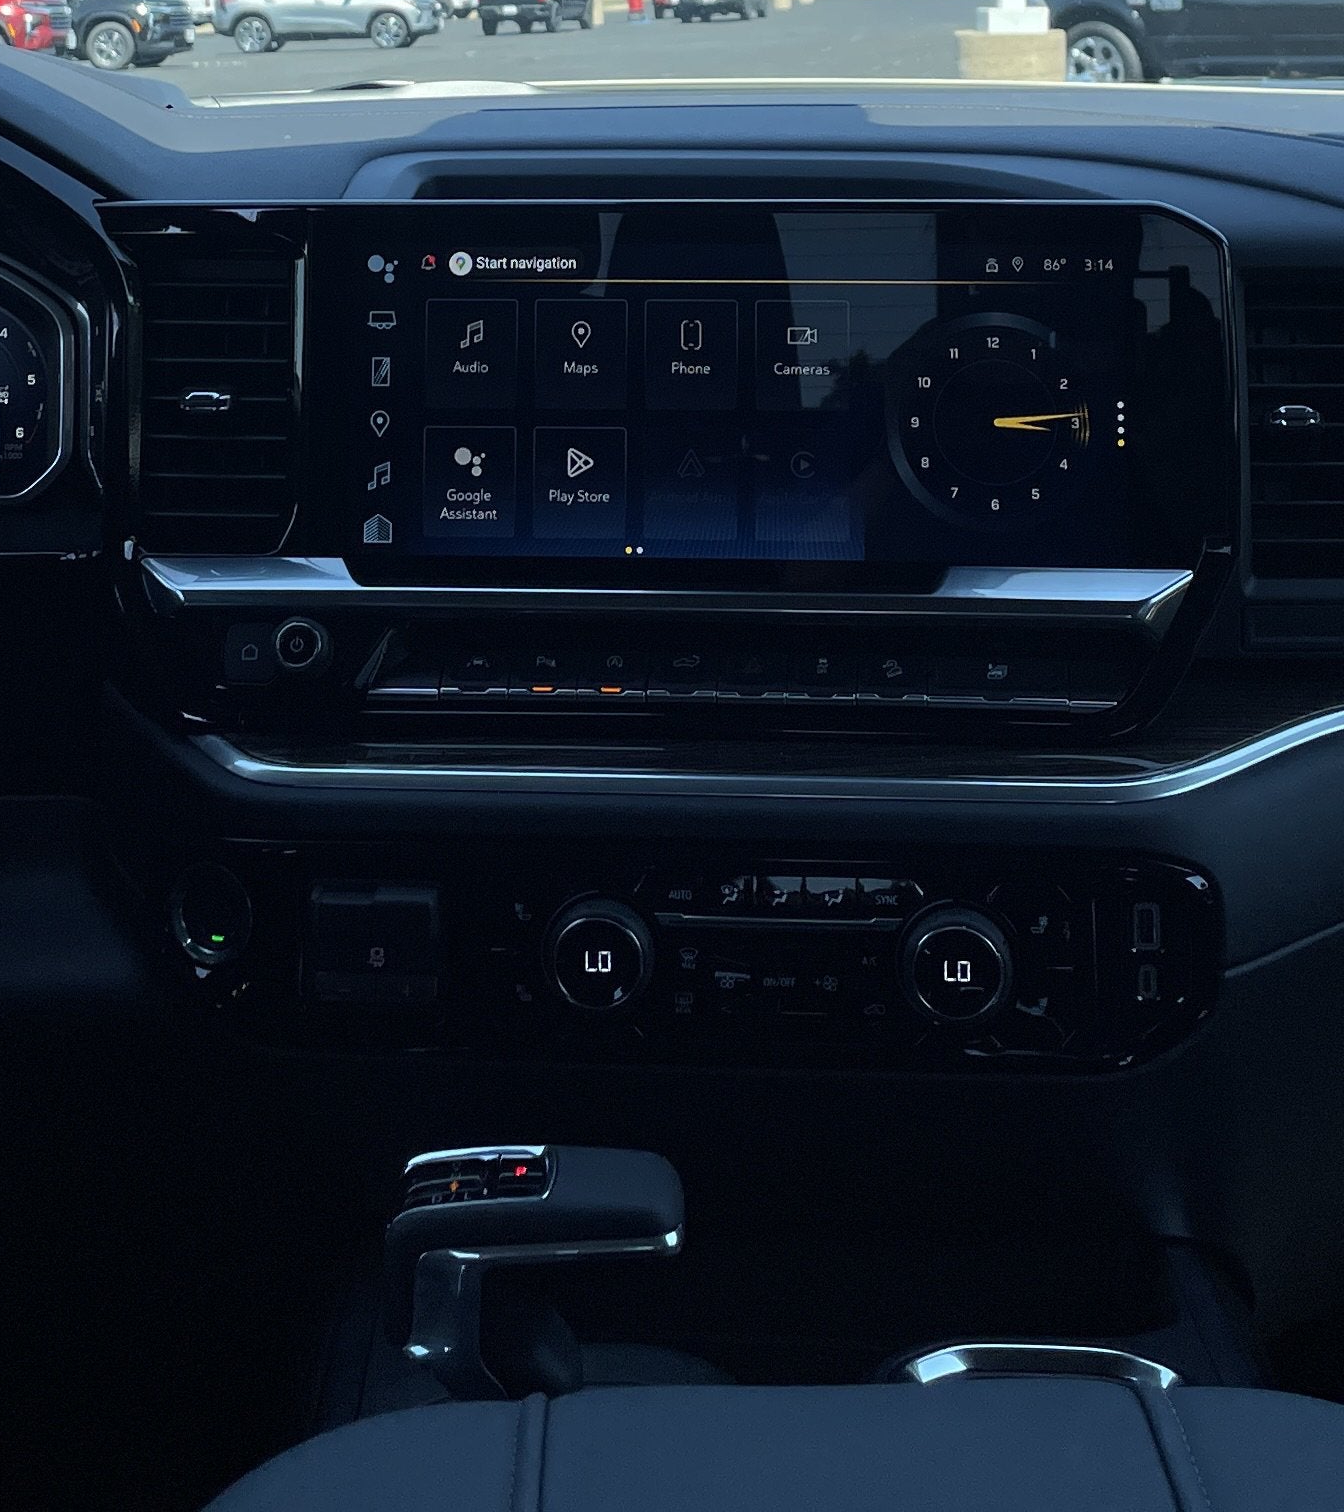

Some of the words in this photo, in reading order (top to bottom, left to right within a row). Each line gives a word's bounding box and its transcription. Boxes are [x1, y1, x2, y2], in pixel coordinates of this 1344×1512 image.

[476, 255, 507, 270] Start
[510, 255, 578, 273] navigation
[1084, 258, 1114, 271] 3:14
[0, 327, 8, 339] 4
[986, 337, 1000, 349] 12
[949, 348, 960, 360] 11
[1030, 348, 1037, 360] 1
[452, 360, 489, 374] Audio
[563, 362, 599, 377] Maps
[670, 361, 711, 375] Phone
[773, 363, 831, 376] Cameras
[27, 374, 36, 385] 5
[917, 377, 931, 389] 10
[1059, 379, 1069, 390] 2
[910, 417, 919, 429] 9
[1071, 418, 1080, 429] 3
[15, 427, 25, 438] 6
[920, 457, 930, 468] 8
[1059, 458, 1068, 470] 4
[446, 489, 492, 505] Google
[548, 490, 575, 506] Play
[577, 490, 611, 503] Store
[950, 488, 959, 499] 7
[1031, 489, 1040, 500] 5
[991, 499, 1000, 510] 6
[439, 507, 498, 521] Assistant
[668, 889, 693, 902] AUTO
[874, 894, 899, 906] SYNC
[585, 950, 612, 973] LO
[943, 959, 971, 983] LO
[763, 976, 797, 988] ON/OFF
